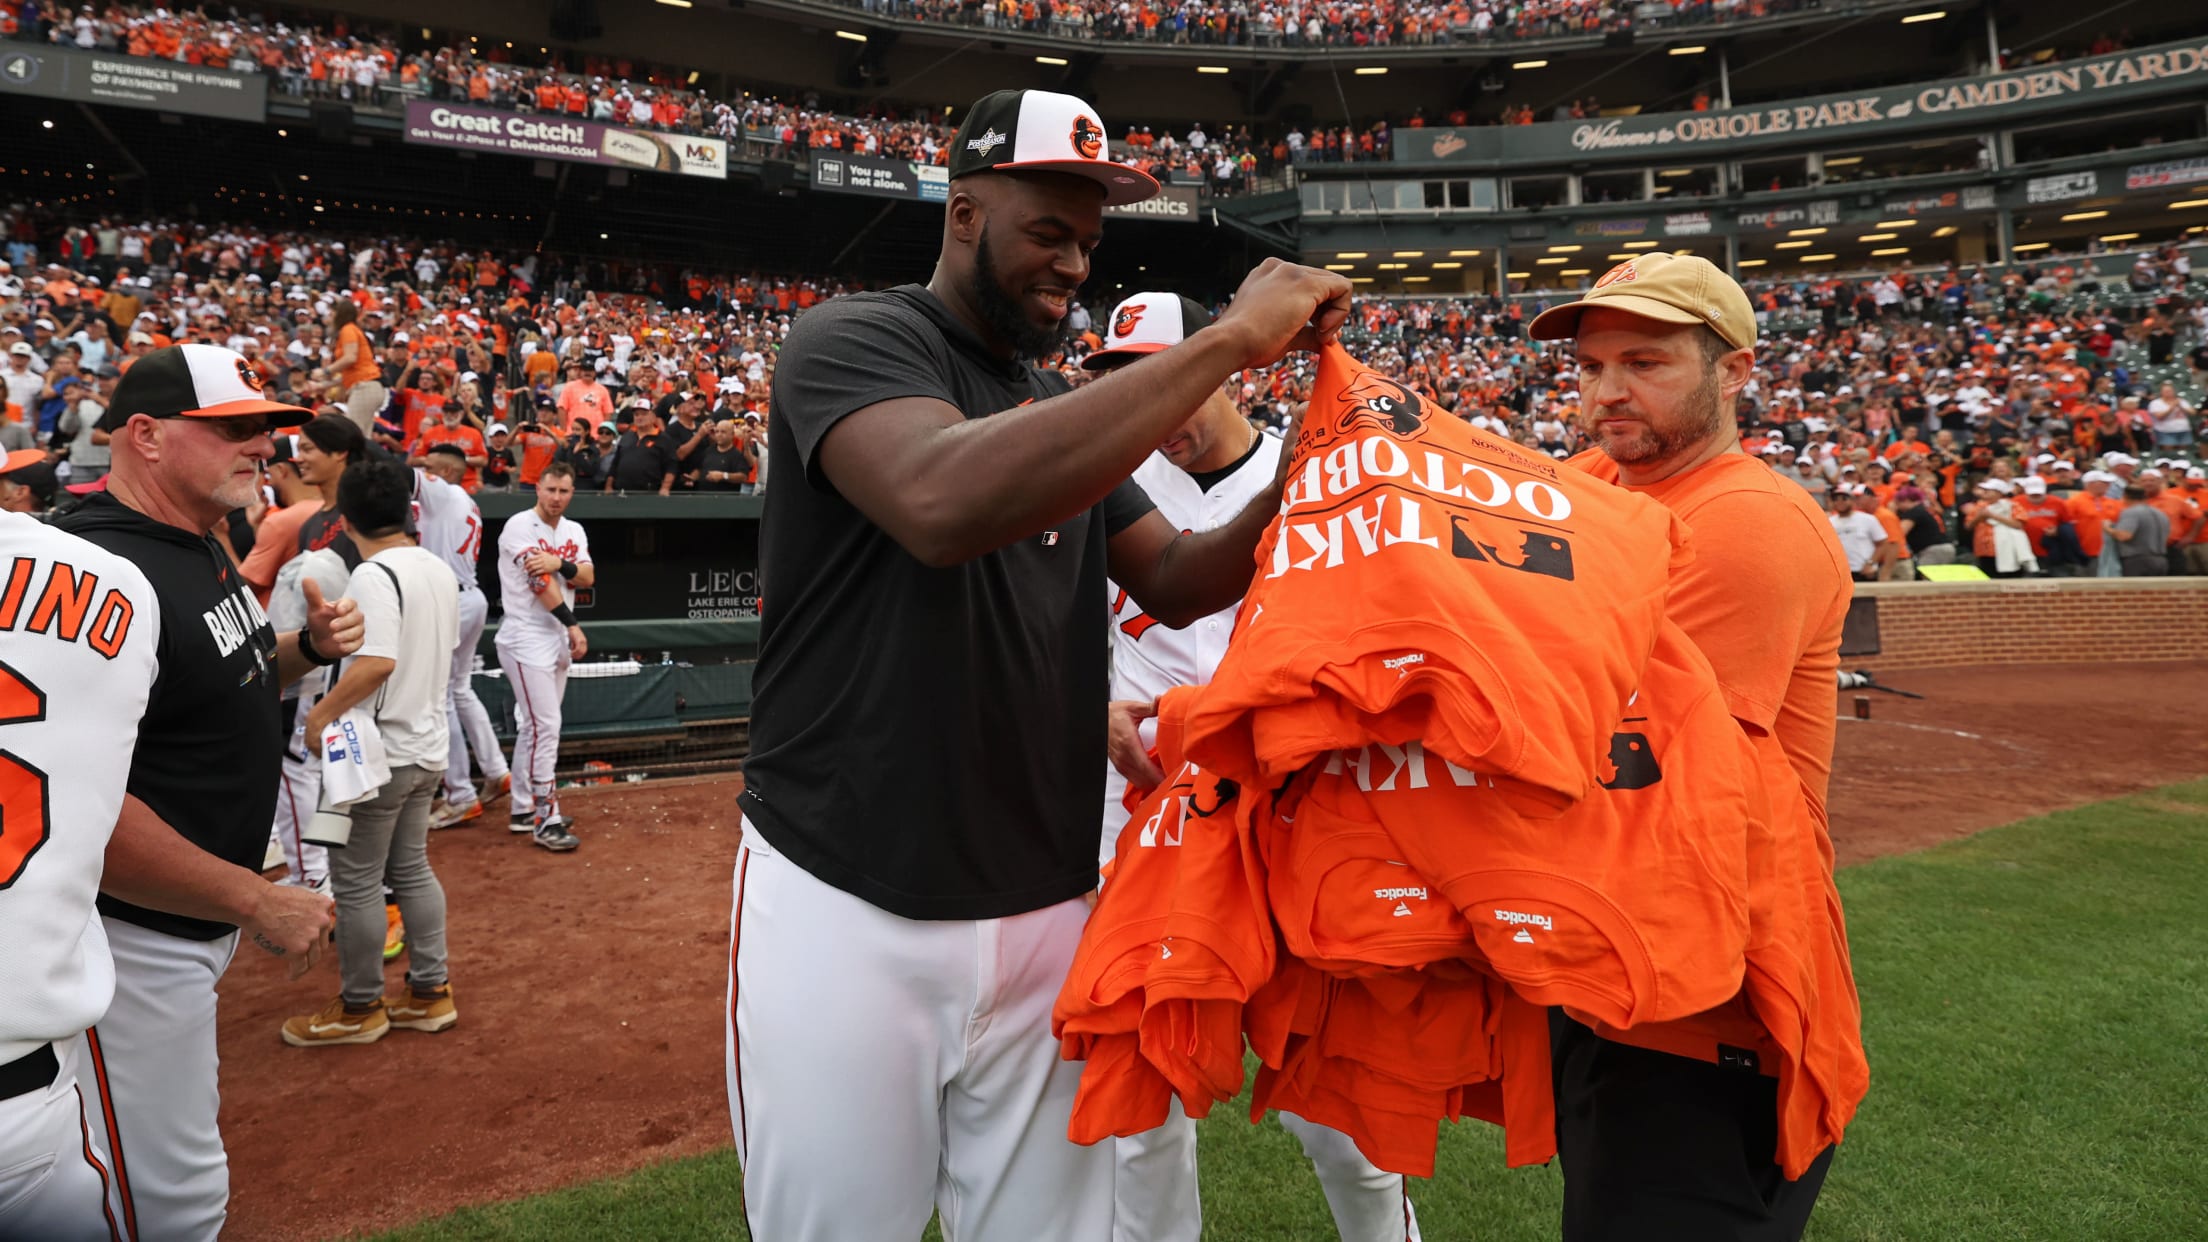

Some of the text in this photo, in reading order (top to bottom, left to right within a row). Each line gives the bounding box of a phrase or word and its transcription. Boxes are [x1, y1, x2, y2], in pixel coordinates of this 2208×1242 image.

[91, 73, 179, 93] OF PAYMENTS
[92, 59, 242, 89] EXPERIENCE THE FUTURE
[1571, 119, 1655, 149] Welcome
[1654, 129, 1675, 144] to
[1676, 109, 1793, 141] ORIOLE
[1794, 97, 1885, 129] PARK
[1917, 66, 2082, 113] CAMDEN
[430, 108, 584, 143] Great Catch!
[411, 128, 430, 138] Get
[431, 130, 455, 141] Your
[496, 139, 507, 147] at
[849, 165, 872, 177] You
[873, 169, 892, 179] are
[851, 177, 907, 191] not alone.
[1110, 196, 1190, 216] anatics
[1280, 435, 1572, 521] OCTOBE
[688, 597, 715, 608] LAKE
[717, 596, 741, 608] ERIE
[688, 607, 756, 619] OSTEOPATHIC
[342, 721, 363, 765] GEICO
[1373, 887, 1428, 900] Fanatics
[1494, 909, 1553, 931] Fanatics
